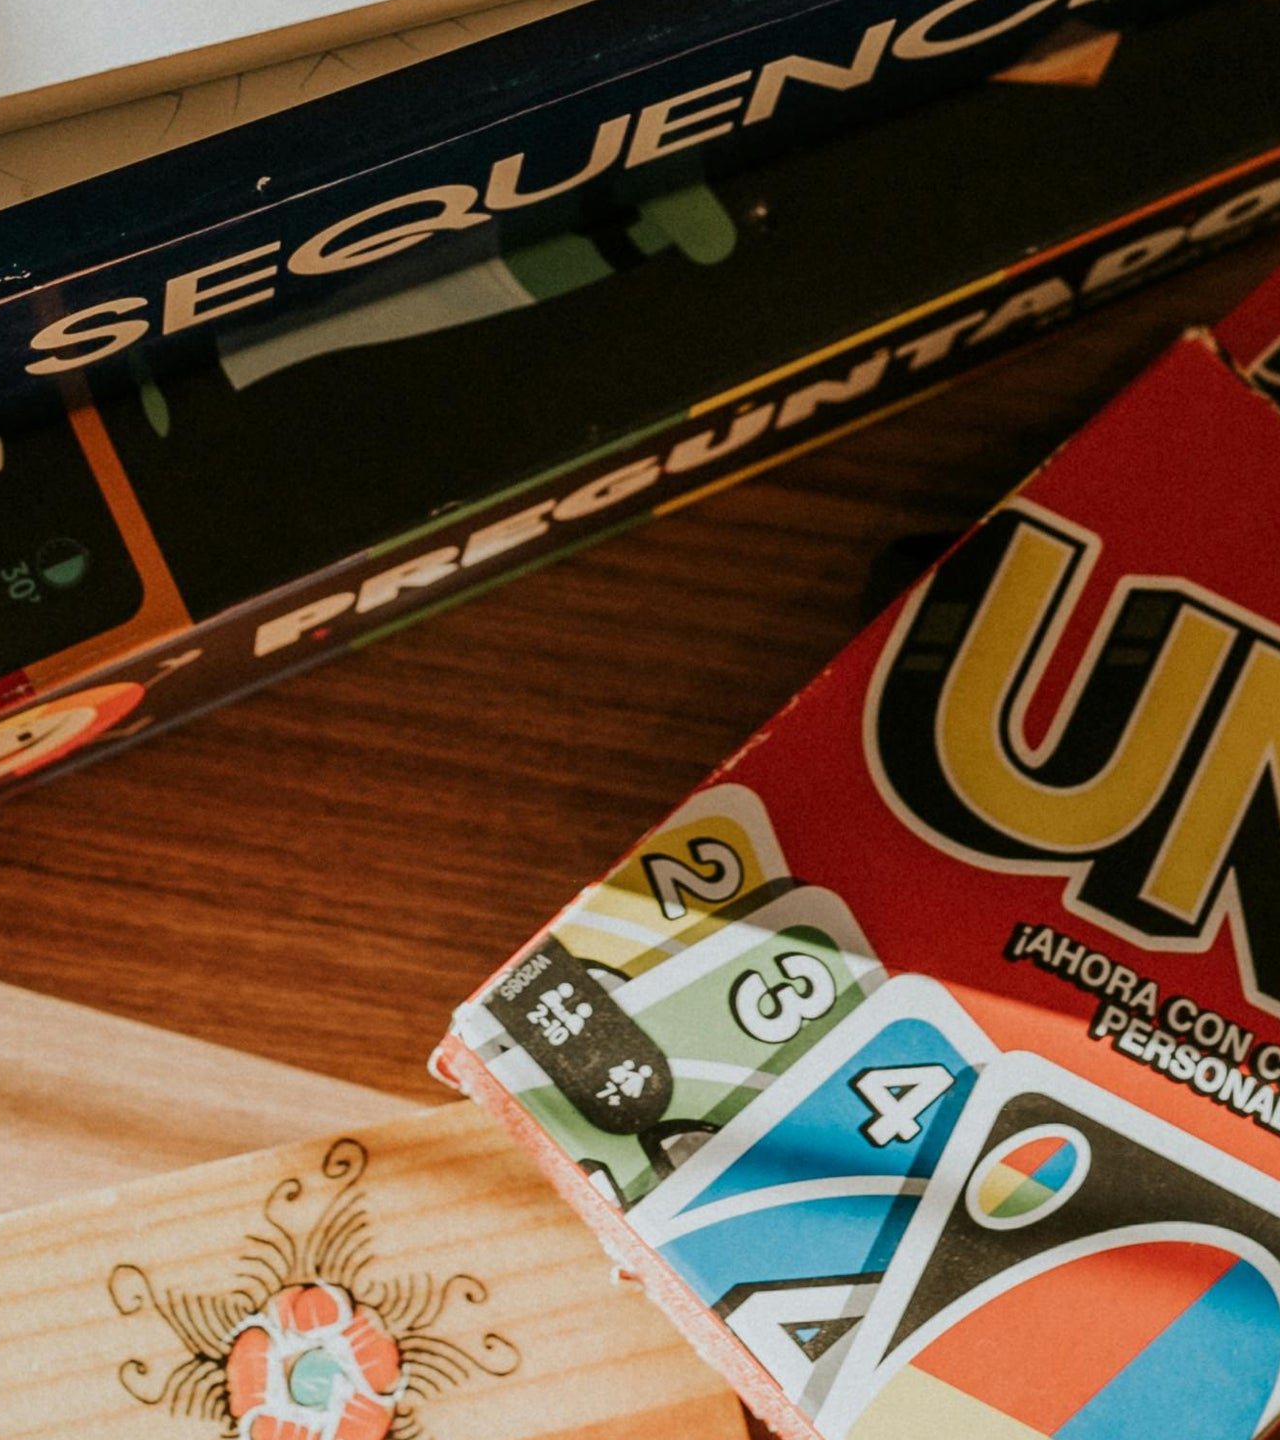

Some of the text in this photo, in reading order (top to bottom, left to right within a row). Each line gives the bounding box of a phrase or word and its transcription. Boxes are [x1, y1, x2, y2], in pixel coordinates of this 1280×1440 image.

[641, 837, 744, 921] 2
[526, 1004, 570, 1047] 2-10
[729, 952, 837, 1045] 3
[1011, 924, 1160, 1017] ¡AHORA
[1166, 998, 1254, 1063] CON
[595, 1081, 622, 1107] 7+
[848, 1063, 957, 1148] 4
